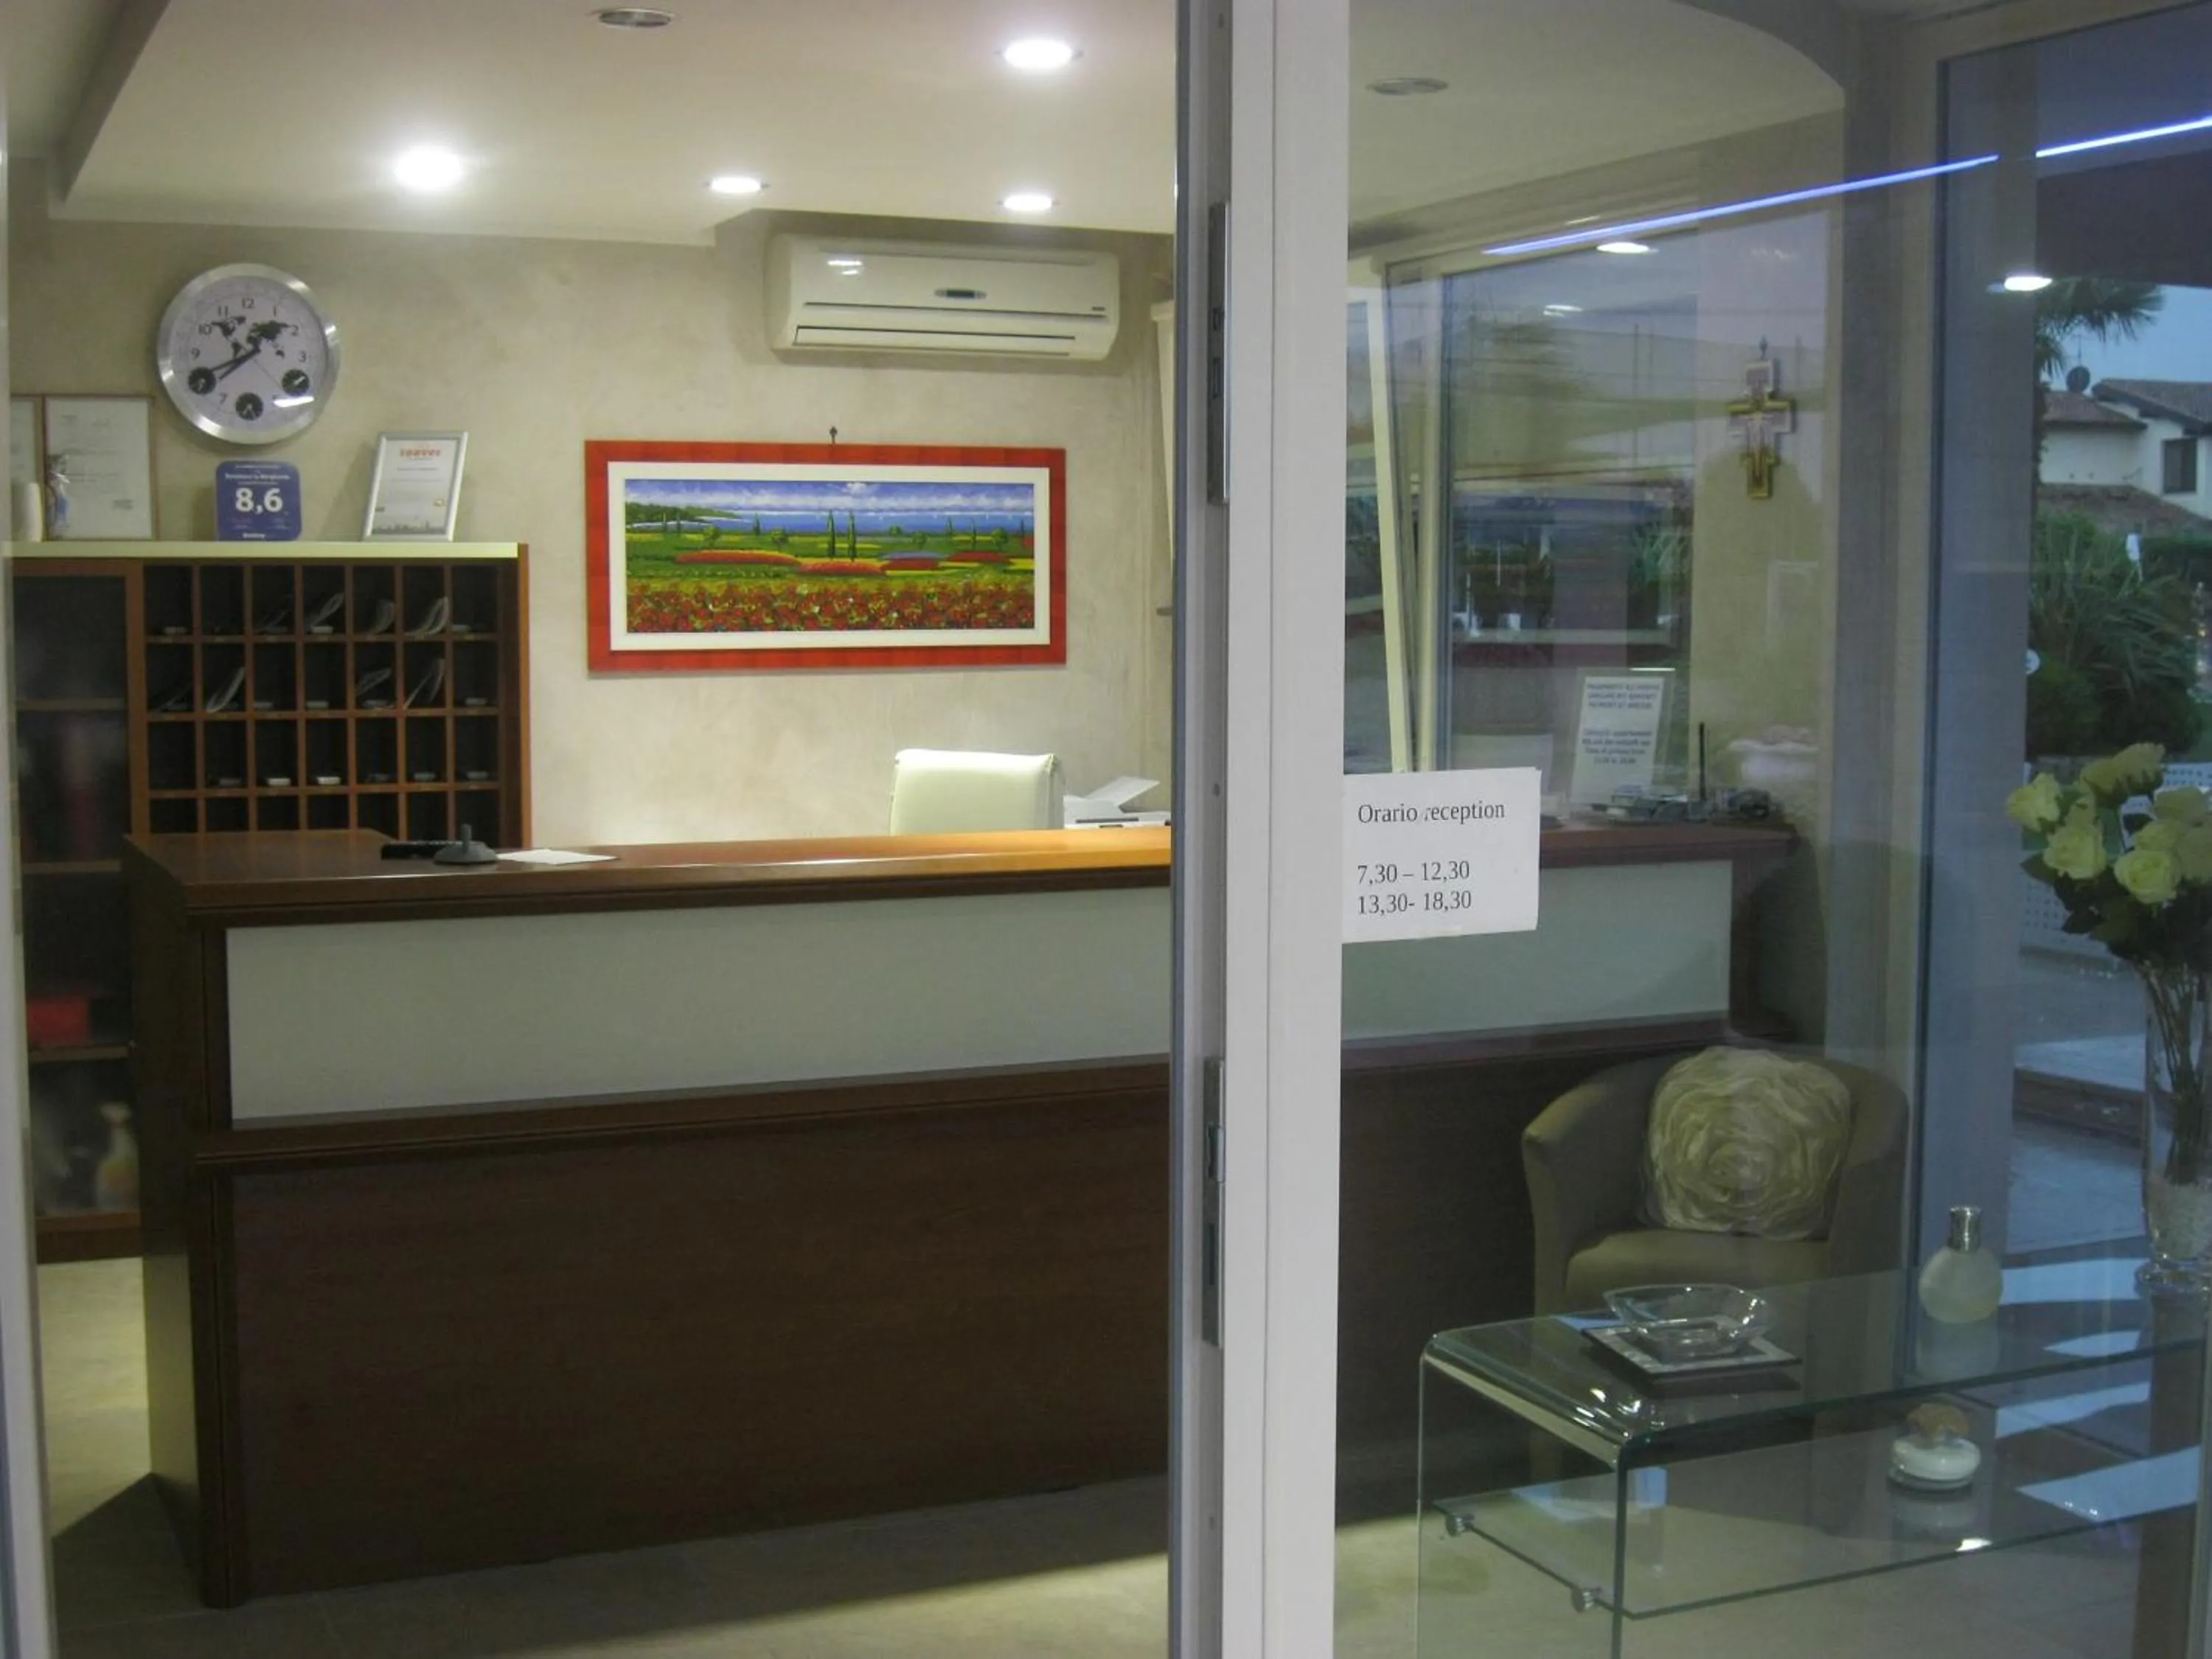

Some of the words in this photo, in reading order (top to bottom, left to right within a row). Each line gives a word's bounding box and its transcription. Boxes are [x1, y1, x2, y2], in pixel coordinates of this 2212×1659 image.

[242, 298, 255, 309] 12
[218, 305, 229, 317] 11
[272, 305, 277, 317] 1
[198, 324, 212, 335] 10
[291, 325, 299, 336] 2
[191, 347, 201, 360] 9
[299, 351, 307, 363] 3
[220, 393, 227, 404] 7
[235, 487, 283, 515] 8,6
[1358, 803, 1418, 823] Orario
[1424, 800, 1505, 824] reception
[1357, 863, 1397, 885] 7,30
[1422, 860, 1470, 883] 12,30
[1358, 893, 1415, 916] 13,30-
[1423, 890, 1471, 911] 18,30
